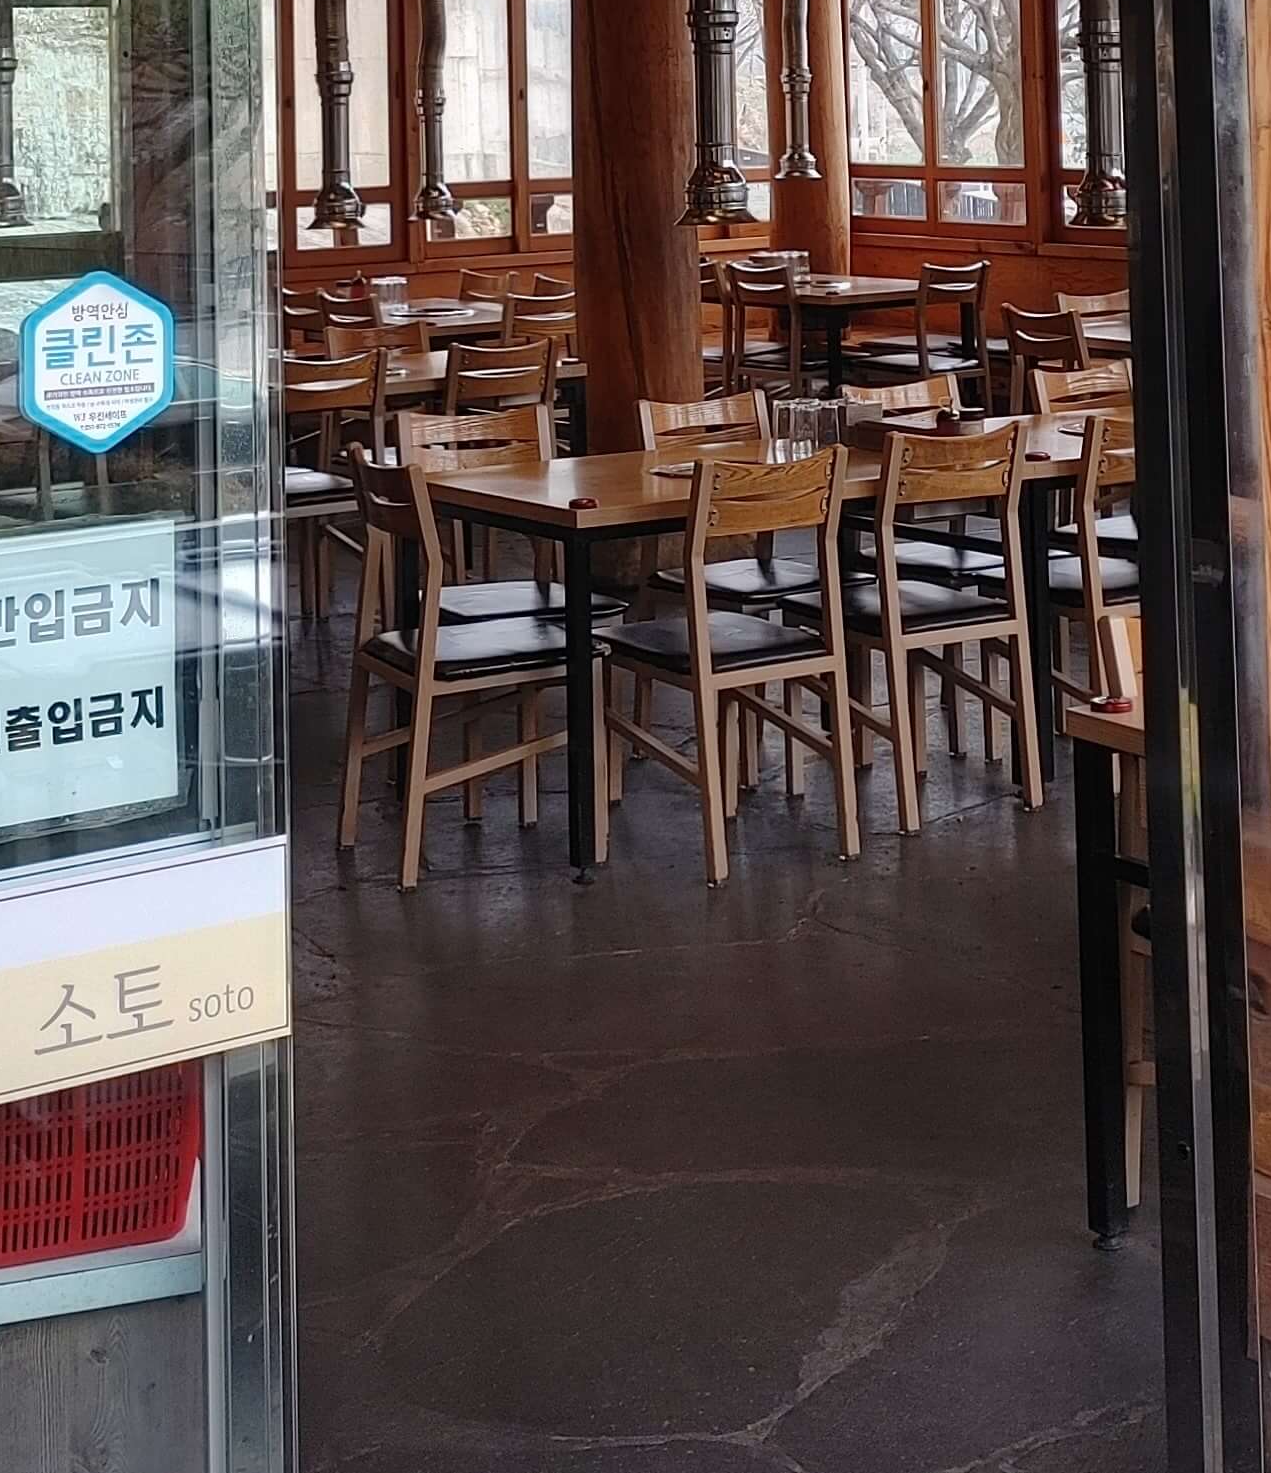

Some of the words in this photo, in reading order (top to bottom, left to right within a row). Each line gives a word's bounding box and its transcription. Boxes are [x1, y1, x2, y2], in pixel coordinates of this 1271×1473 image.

[71, 301, 130, 322] 방역안심
[42, 324, 157, 370] 클린존
[60, 371, 101, 386] CLEAN
[105, 369, 140, 382] ZONE
[34, 965, 174, 1056] 소토
[188, 984, 255, 1023] soto
